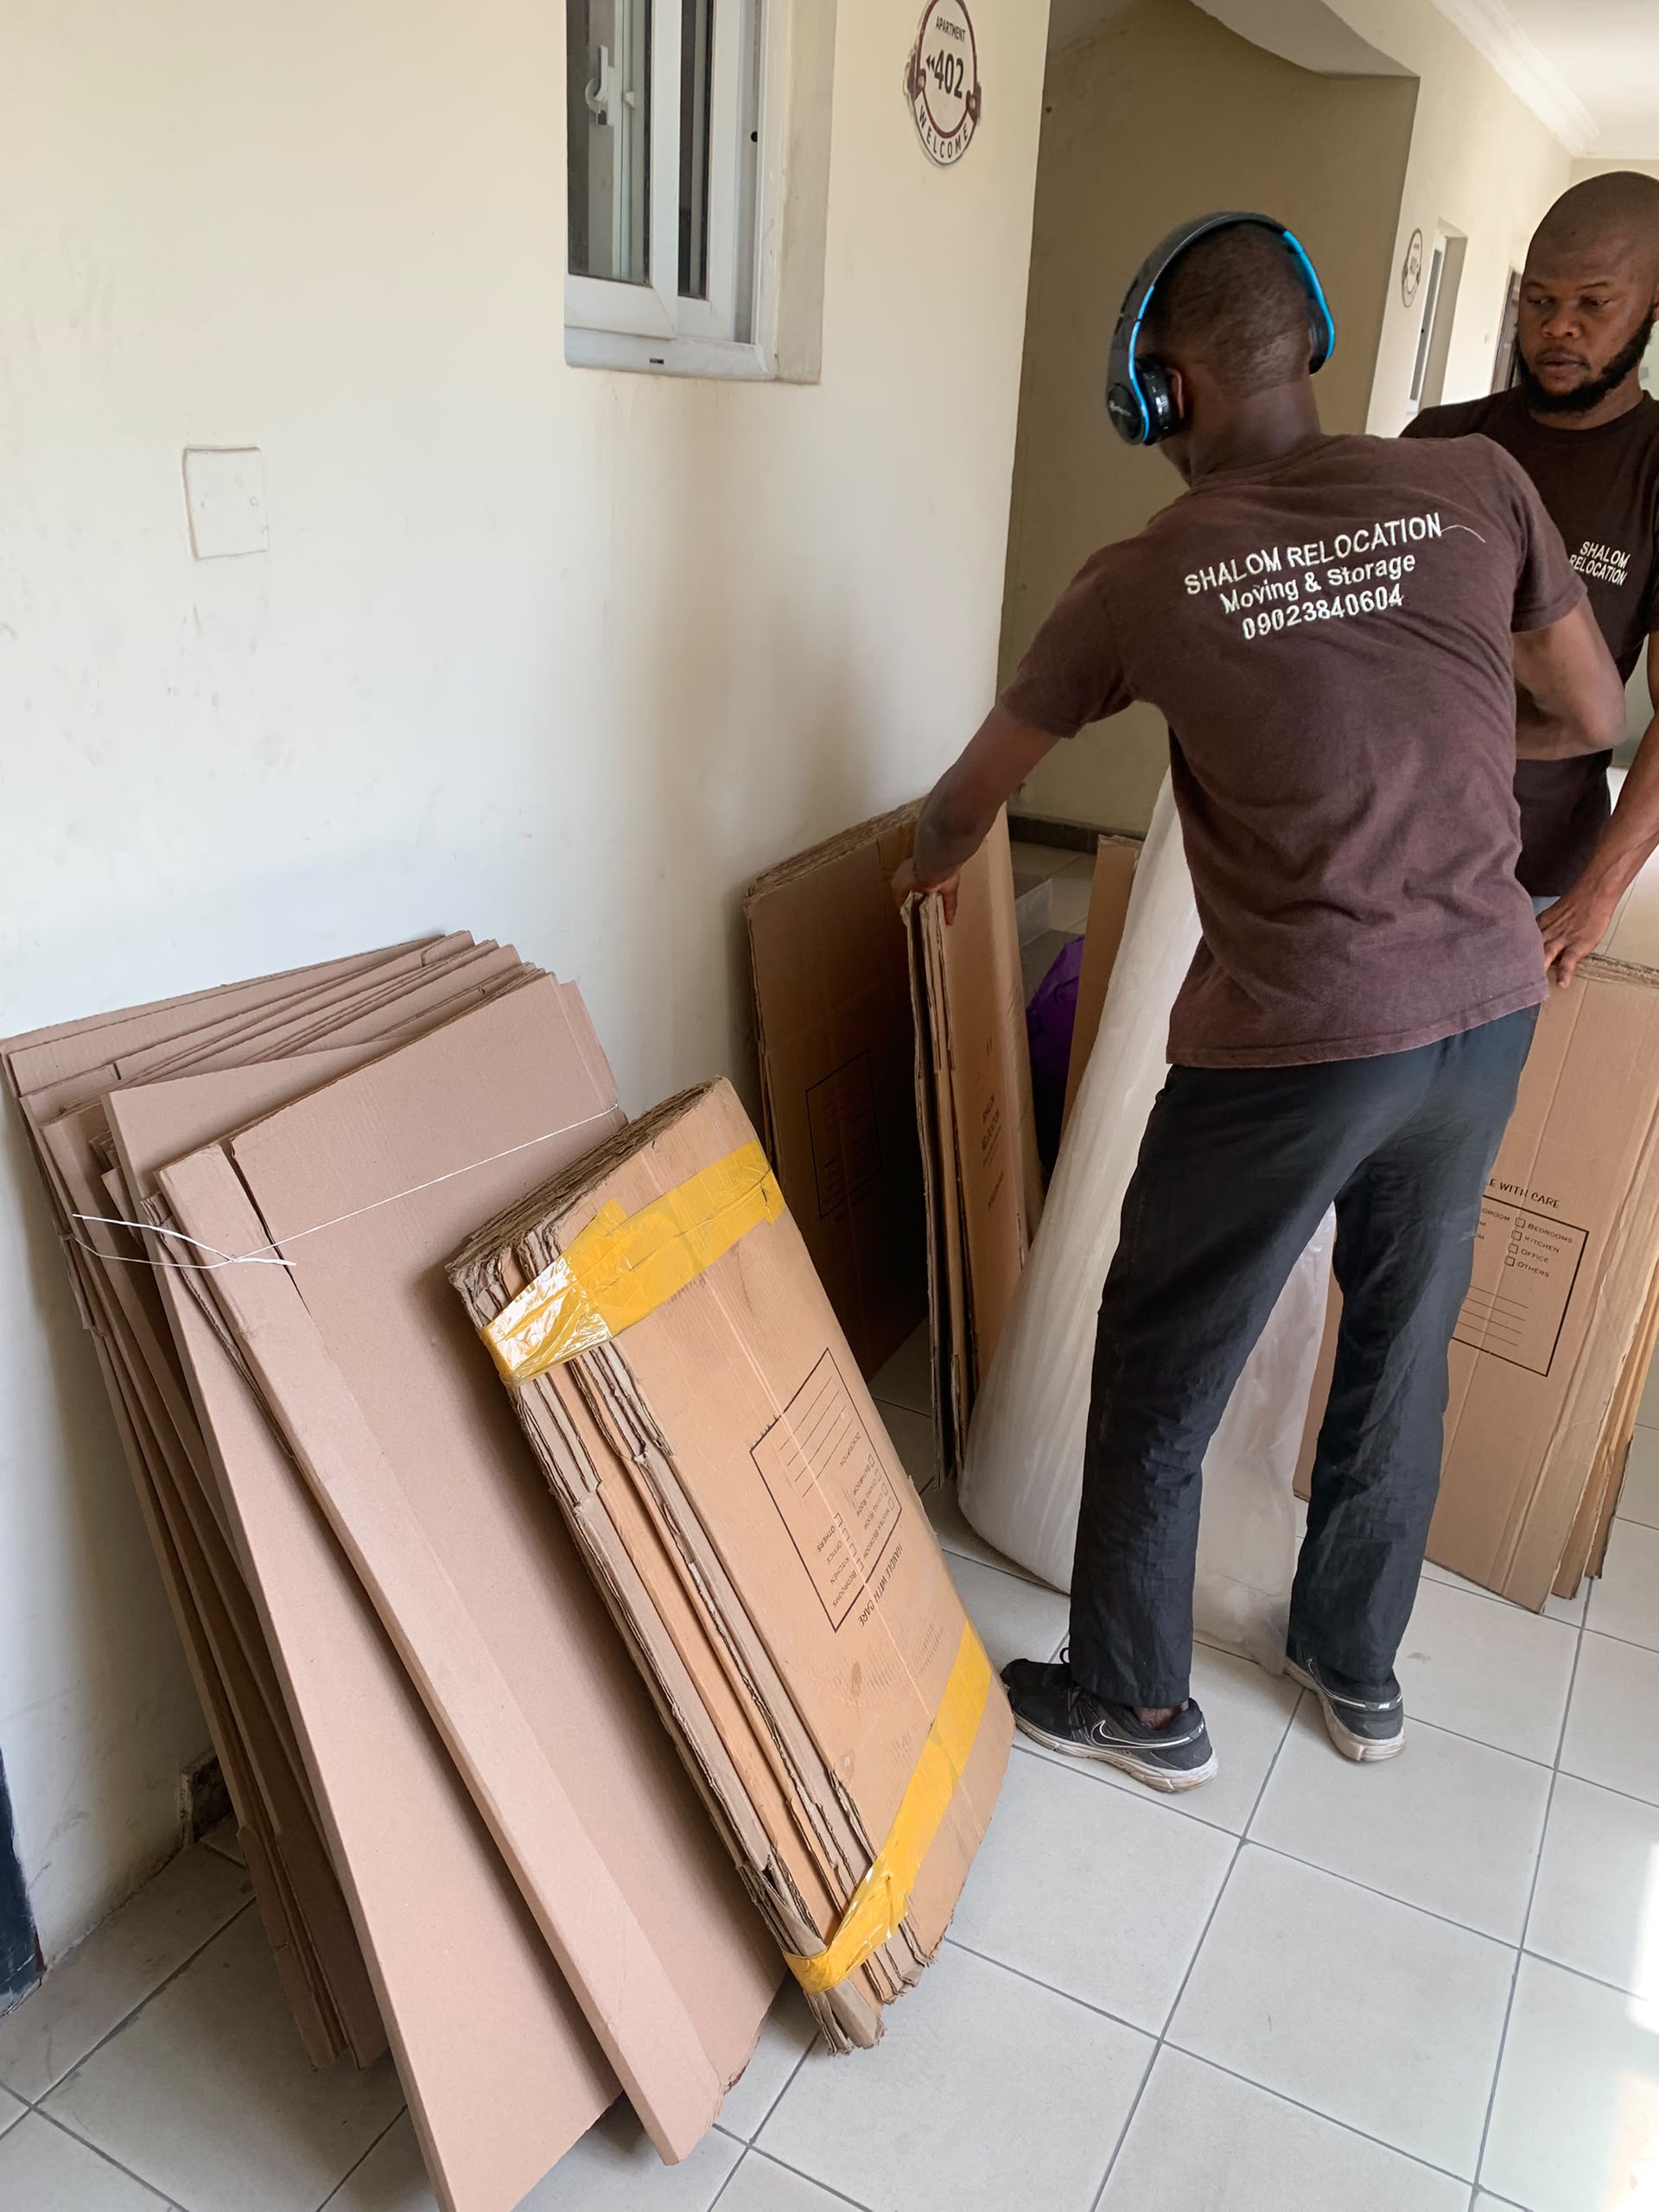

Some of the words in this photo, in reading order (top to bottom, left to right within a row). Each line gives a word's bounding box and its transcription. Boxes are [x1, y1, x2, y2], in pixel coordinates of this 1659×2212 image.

[935, 16, 966, 43] APARTMENT
[934, 49, 964, 99] 402
[918, 105, 969, 159] WELCOME
[1184, 546, 1282, 595] SHALOM
[1287, 512, 1442, 568] RELOCATION
[1580, 541, 1630, 569] SHALOM
[1219, 579, 1299, 614] Moving
[1305, 571, 1322, 594] &
[1328, 551, 1417, 587] Storage
[1569, 554, 1629, 587] RELOCATION
[1242, 582, 1406, 640] 09023840604
[1499, 1181, 1529, 1198] WITH
[1530, 1192, 1561, 1210] CARE
[1482, 1208, 1510, 1222] DROOM
[1524, 1236, 1560, 1254] KITCHEN
[1527, 1223, 1573, 1244] BEDROOMS
[1517, 1261, 1549, 1278] OTHERS
[1520, 1248, 1549, 1264] OFFICE
[817, 1525, 836, 1553] OTHERS
[826, 1540, 843, 1565] OFFICE
[830, 1557, 850, 1585] KITCHEN
[885, 1542, 903, 1579] HANDLE
[832, 1570, 857, 1608] BEDROOMS
[874, 1575, 888, 1604] WITH
[857, 1599, 874, 1628] CARE
